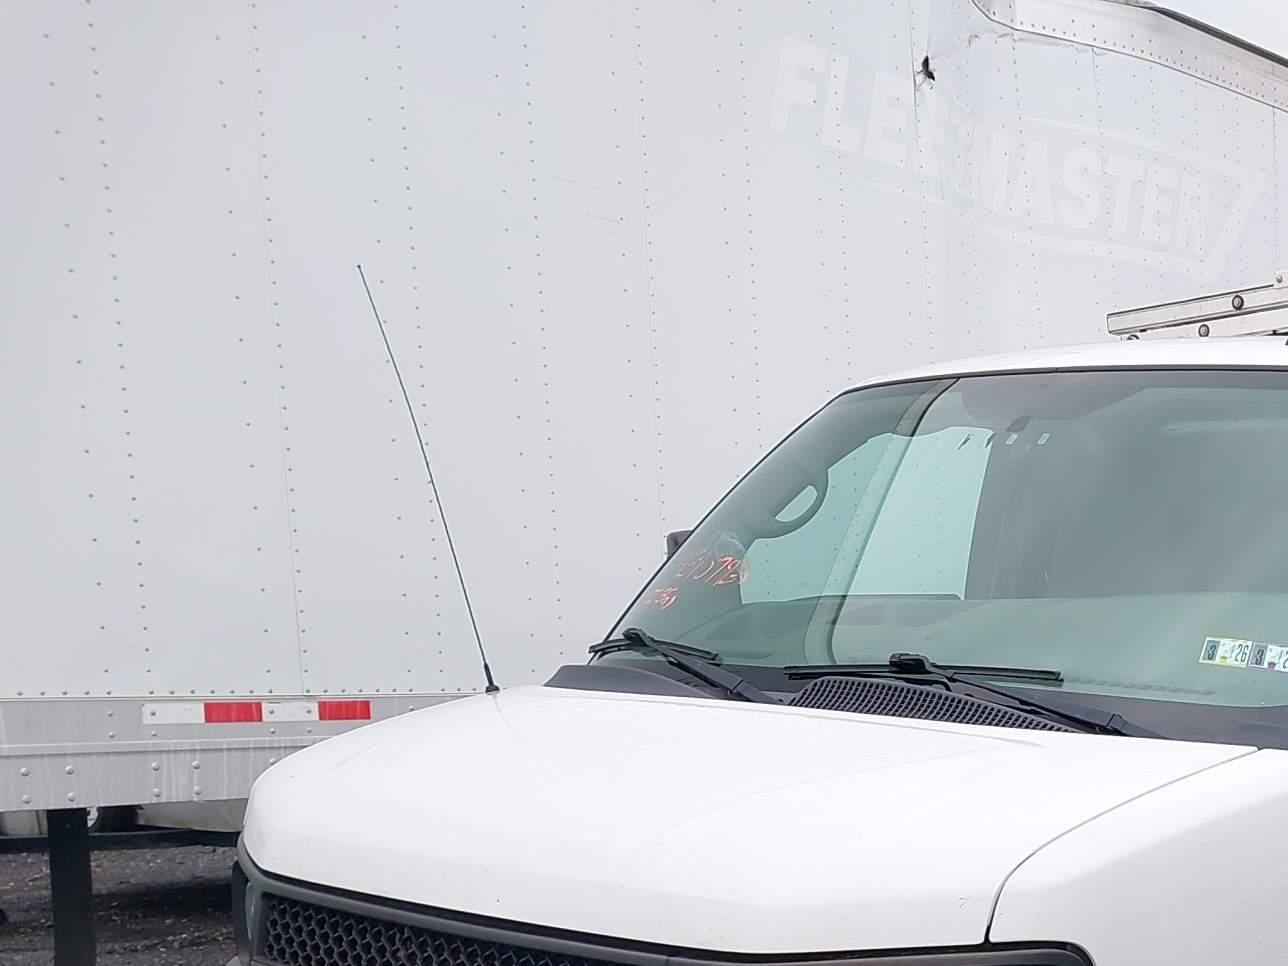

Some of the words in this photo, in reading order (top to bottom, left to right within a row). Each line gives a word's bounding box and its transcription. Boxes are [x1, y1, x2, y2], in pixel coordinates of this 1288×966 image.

[1207, 644, 1217, 661] 3
[1235, 643, 1249, 662] 26
[1255, 649, 1265, 666] 3
